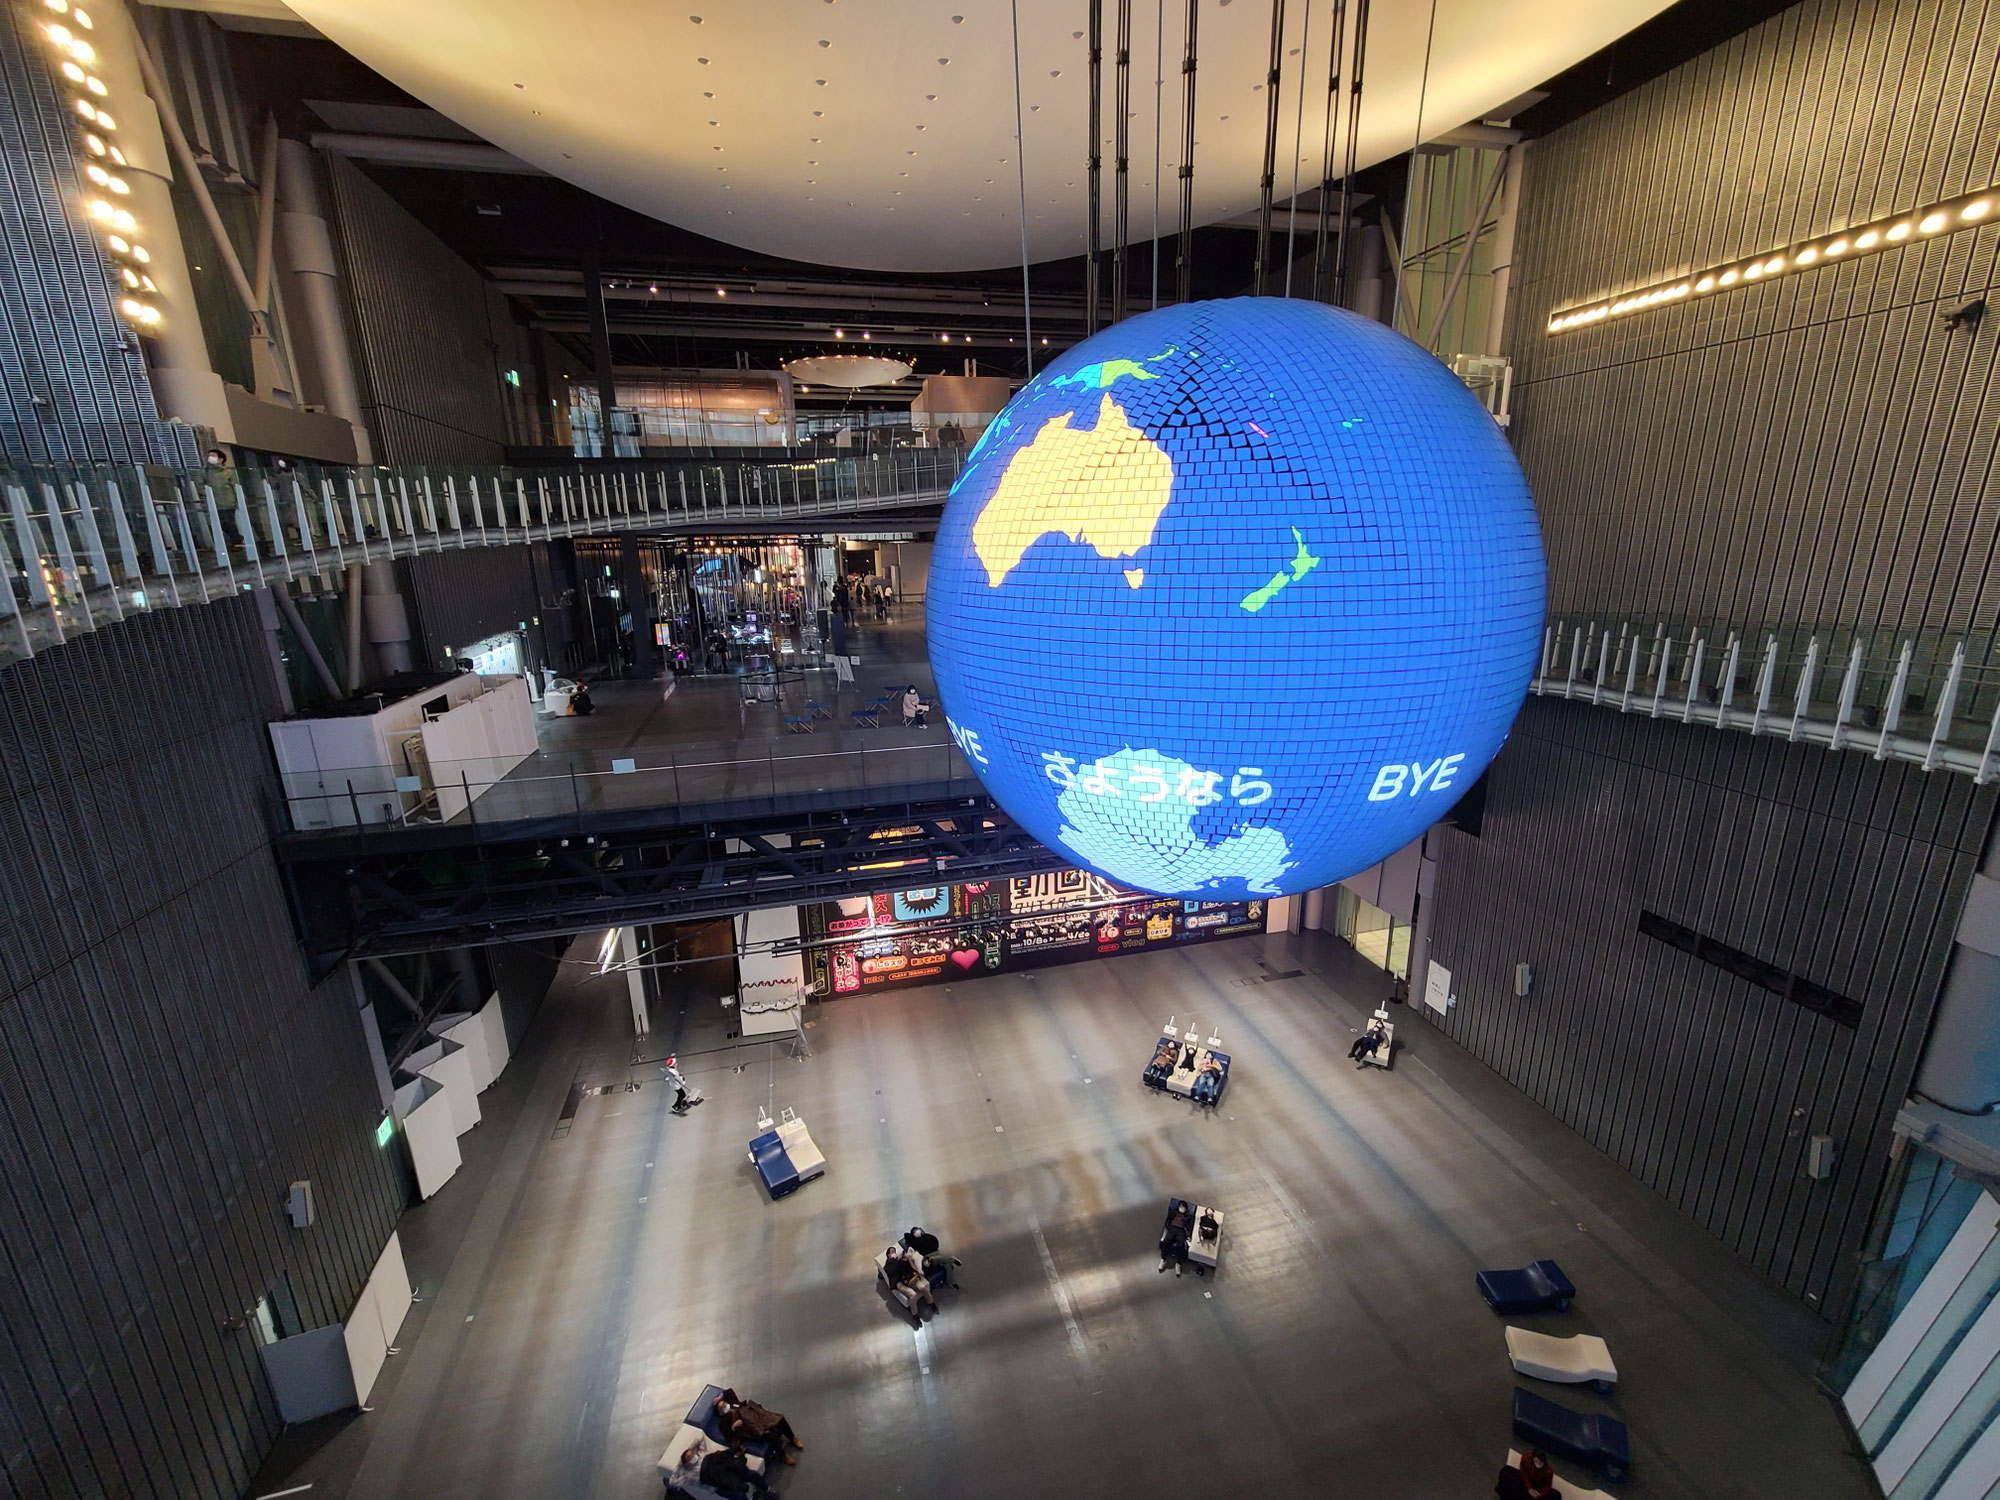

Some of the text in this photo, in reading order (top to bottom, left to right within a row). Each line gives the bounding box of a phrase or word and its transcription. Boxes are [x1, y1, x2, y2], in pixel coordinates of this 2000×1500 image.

[945, 715, 989, 765] BYE
[1041, 750, 1273, 806] さようなら
[1367, 752, 1465, 802] BYE
